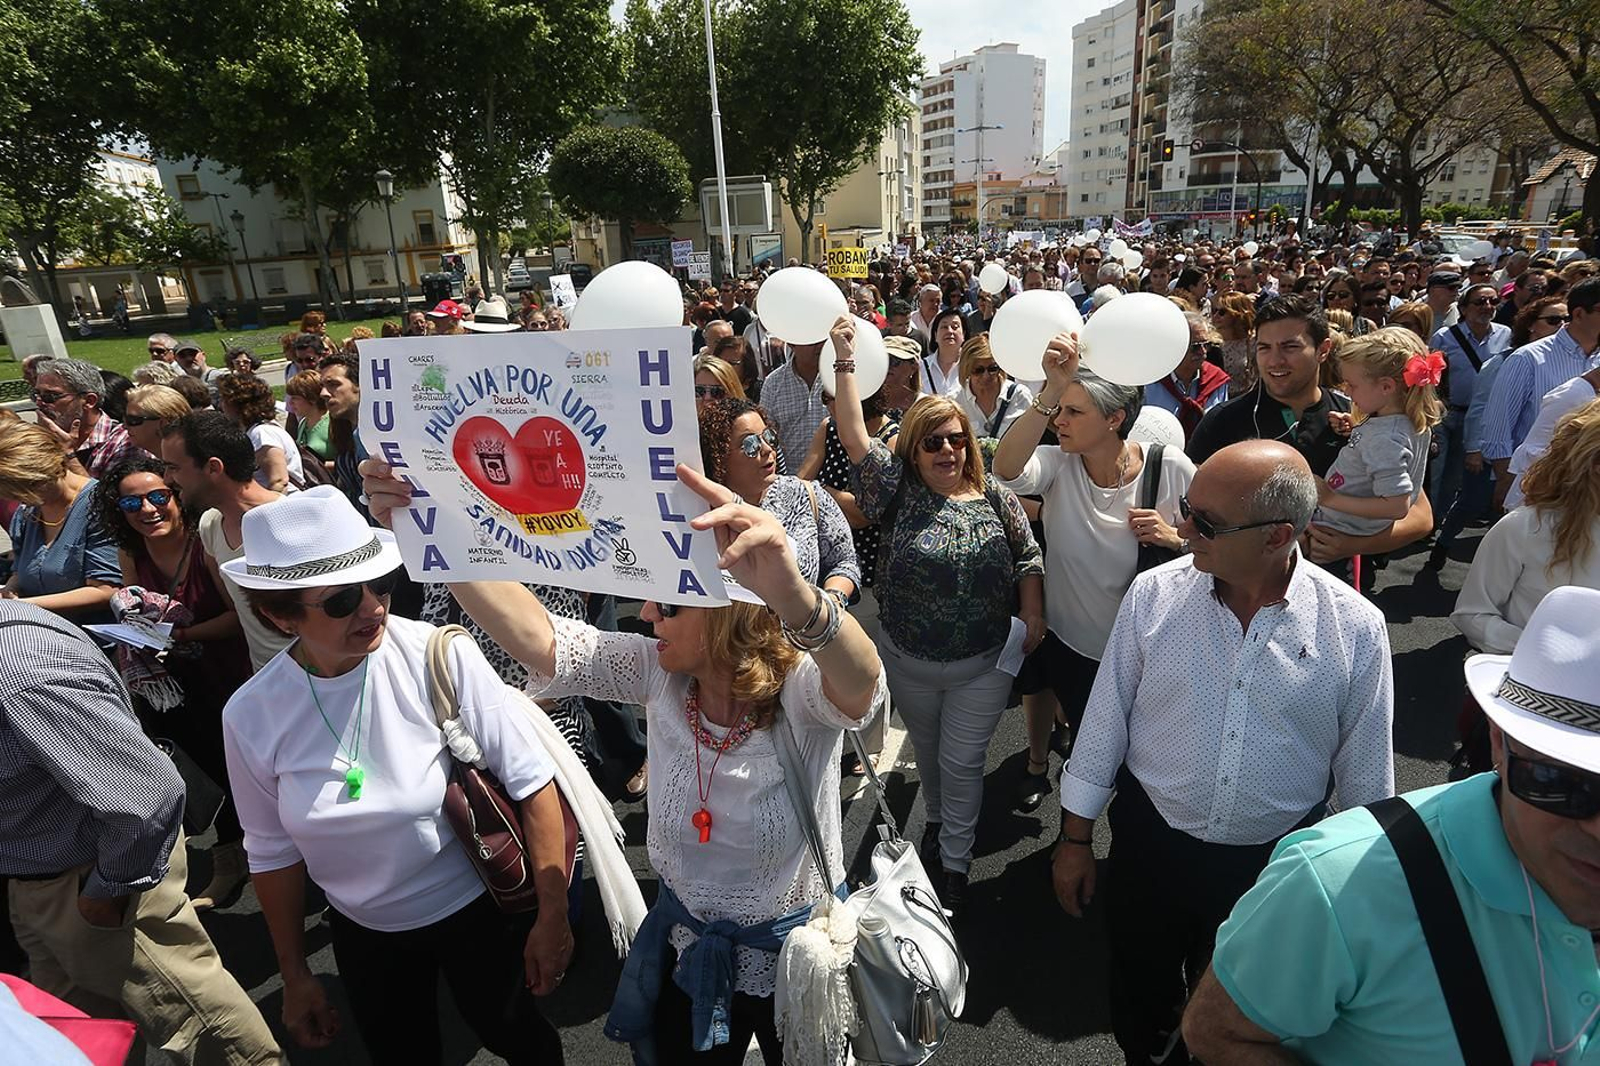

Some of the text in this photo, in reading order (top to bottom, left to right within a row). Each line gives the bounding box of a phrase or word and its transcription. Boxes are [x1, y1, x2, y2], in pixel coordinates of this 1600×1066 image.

[828, 251, 866, 265] ROBAN
[830, 265, 867, 274] TU SALUD!
[585, 352, 610, 367] 061
[571, 374, 608, 384] SIERRA
[424, 368, 499, 444] HUELVA
[506, 365, 553, 406] POR
[561, 387, 607, 446] UNA
[492, 393, 529, 405] Deuda
[371, 358, 450, 572] HUELVA
[587, 463, 623, 471] RIOTINTO
[638, 350, 707, 596] HUELVA
[524, 512, 582, 533] #YOVOY
[466, 504, 561, 570] SANIDAD
[468, 548, 503, 556] MATERNO
[469, 557, 507, 565] INFANTIL
